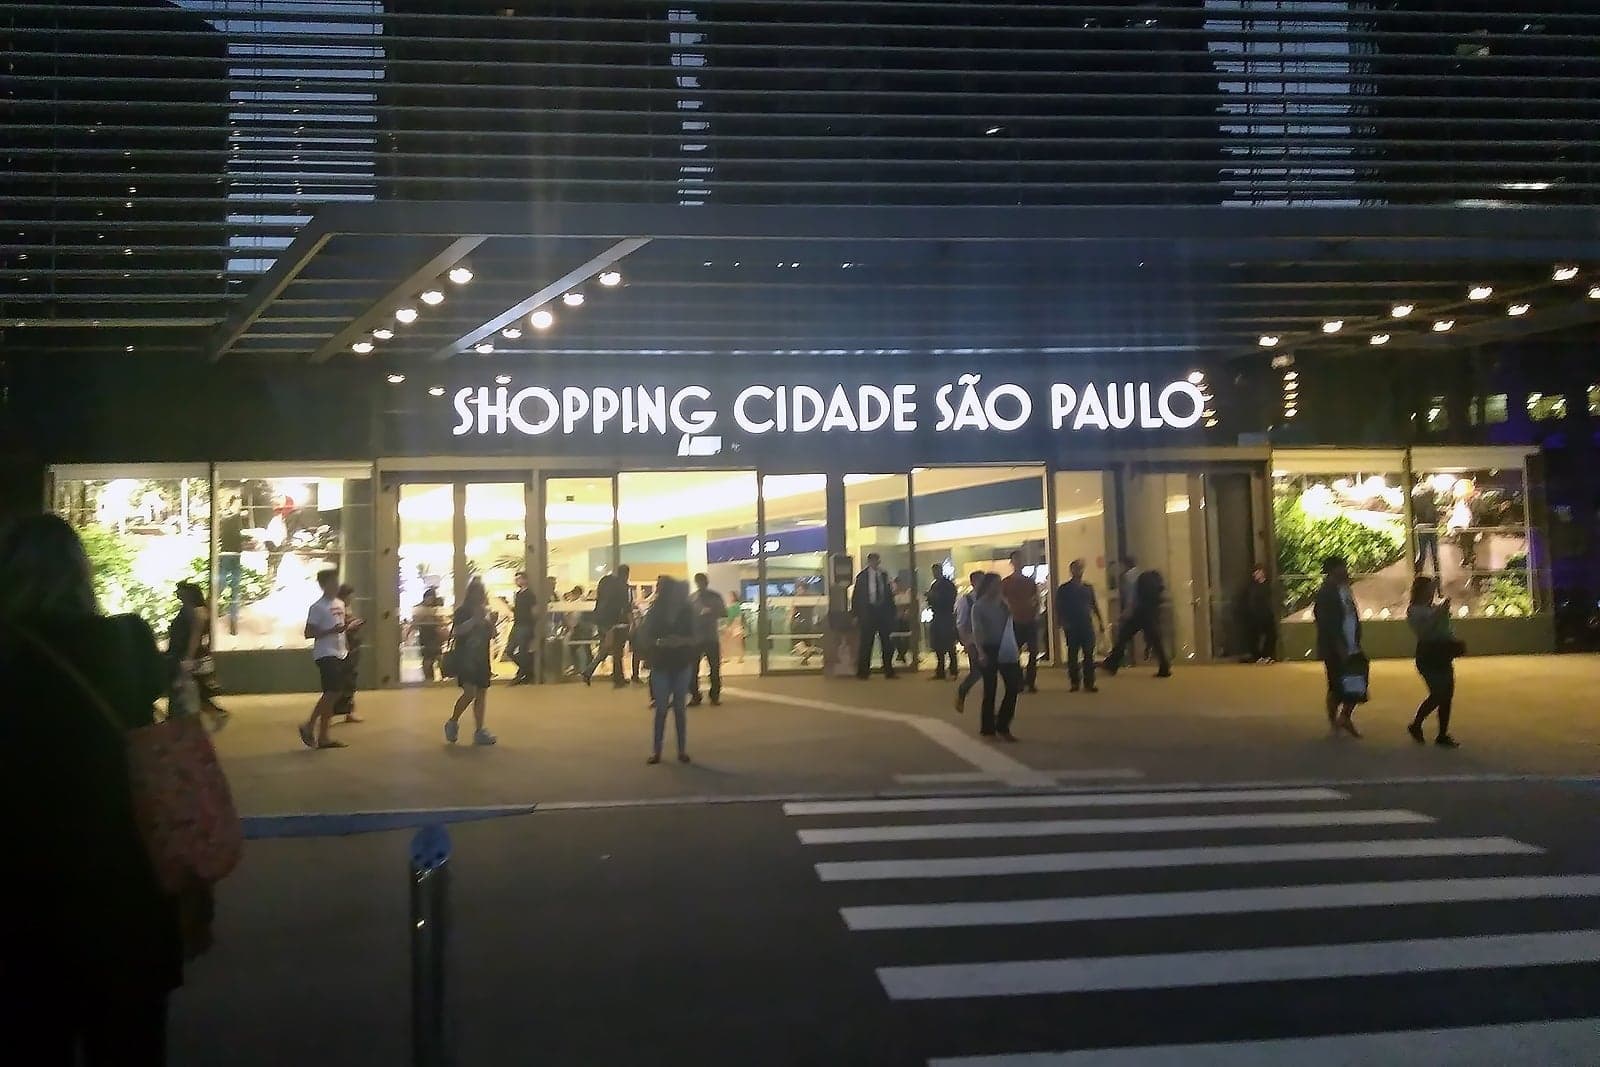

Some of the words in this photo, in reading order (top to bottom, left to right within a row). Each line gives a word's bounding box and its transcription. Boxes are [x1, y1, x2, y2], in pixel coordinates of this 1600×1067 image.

[453, 385, 717, 435] SHOPPING
[733, 383, 918, 432] CIDADE
[935, 373, 1032, 431] SÃO
[1051, 381, 1205, 430] PAULO
